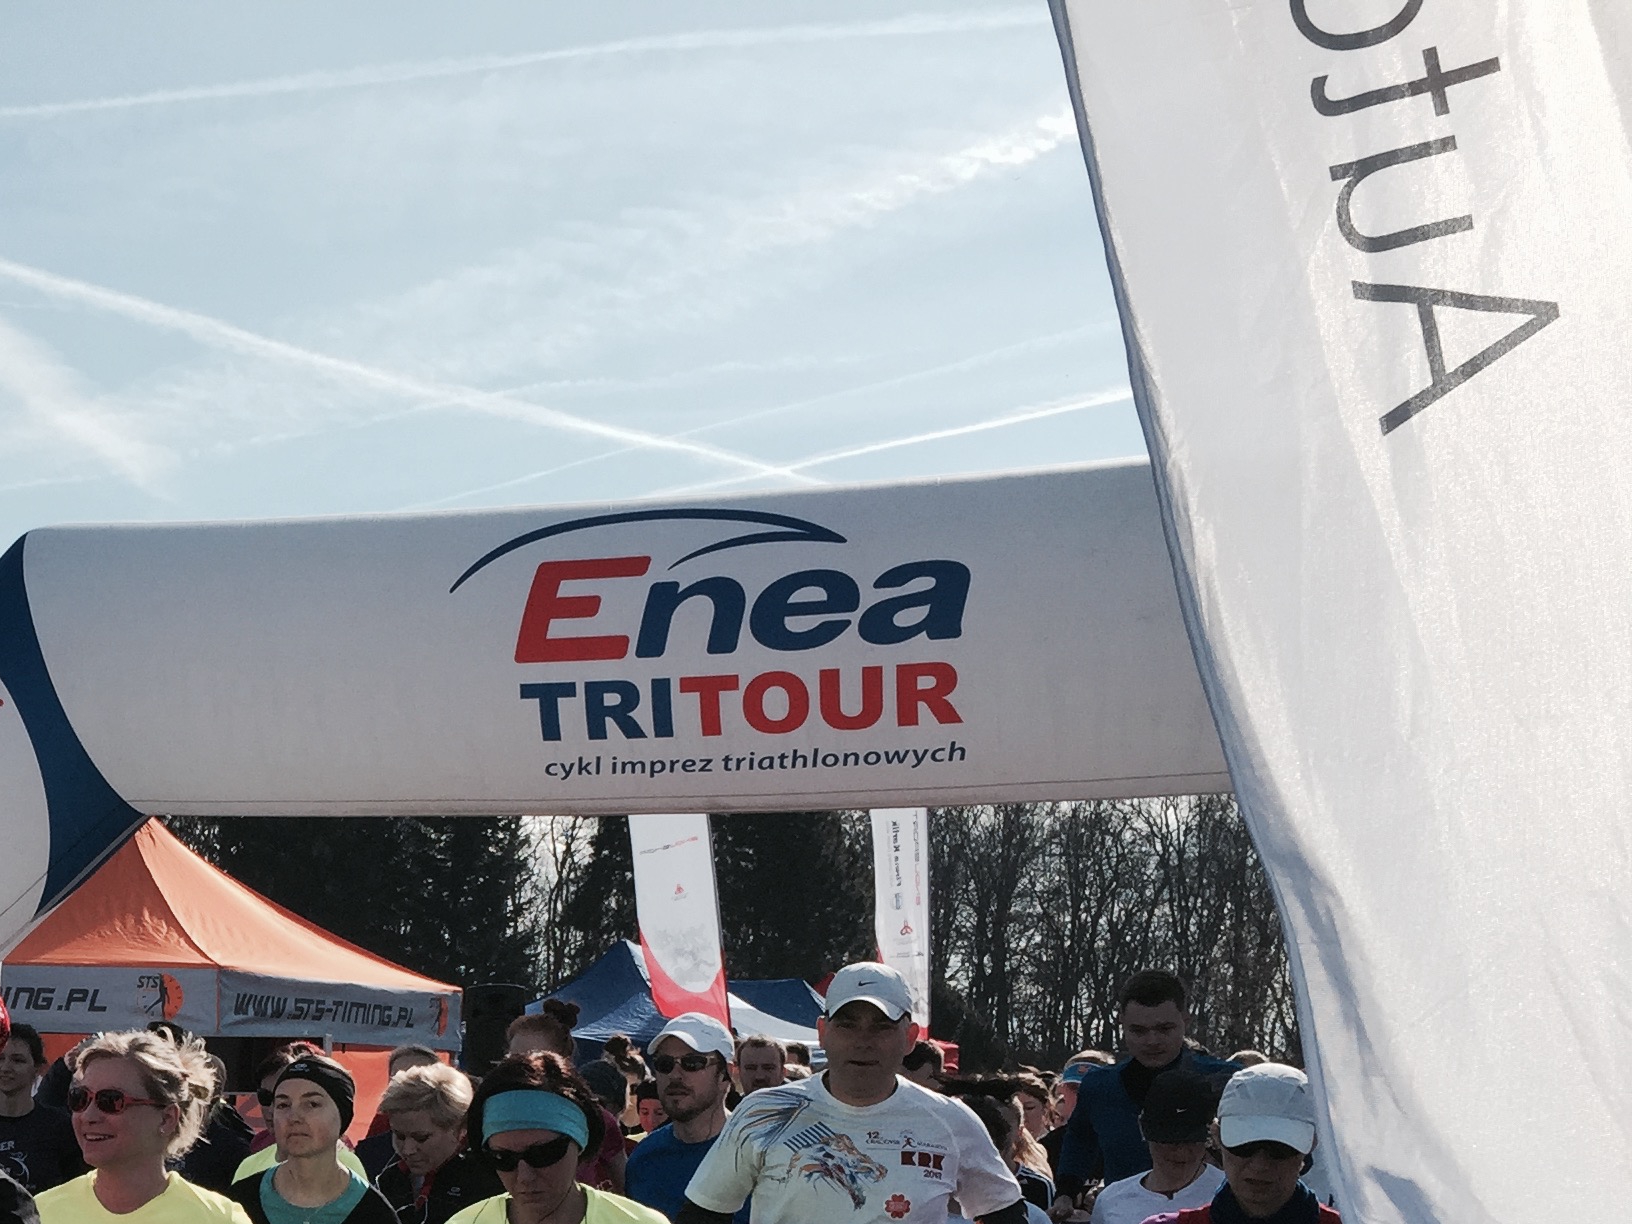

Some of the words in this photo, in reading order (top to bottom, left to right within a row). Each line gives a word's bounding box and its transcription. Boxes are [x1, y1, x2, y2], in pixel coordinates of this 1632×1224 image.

[514, 556, 971, 663] Enea
[520, 662, 964, 741] TRITOUR
[544, 756, 602, 780] cykl
[611, 753, 714, 779] imprez
[722, 741, 967, 772] triathlonowych
[0, 986, 108, 1012] ING.PL
[234, 992, 414, 1028] WWW.STS-TIMING.PL
[901, 1151, 945, 1171] KRK
